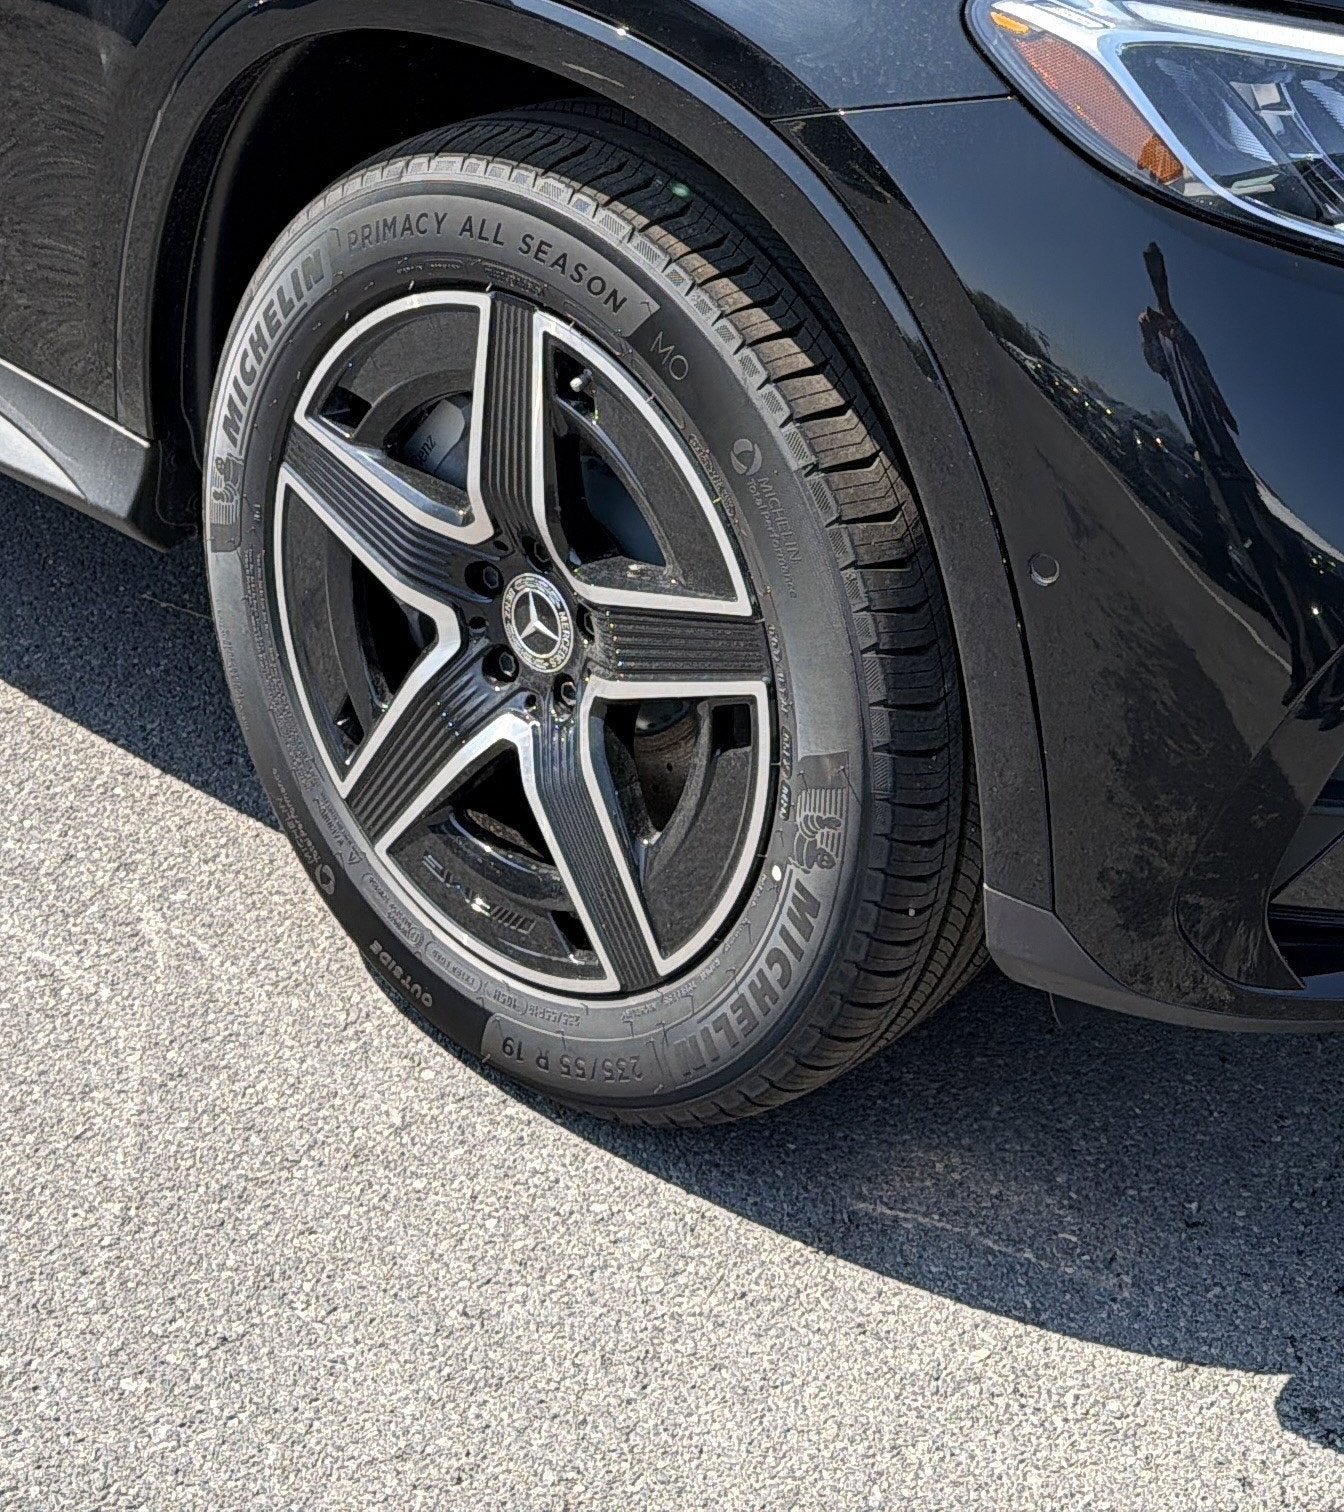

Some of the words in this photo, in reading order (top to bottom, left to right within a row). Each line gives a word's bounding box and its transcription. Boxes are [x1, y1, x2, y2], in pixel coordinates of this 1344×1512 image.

[347, 211, 449, 253] PRIMACY
[459, 215, 506, 247] ALL
[517, 233, 628, 314] SEASON
[222, 248, 325, 445] MICHELIN
[649, 330, 689, 381] MO
[758, 476, 803, 564] MICHELIN
[548, 610, 571, 668] MERCEDES
[368, 938, 434, 1008] OUTSIDE
[672, 876, 822, 1076] MICHELIN
[501, 1036, 525, 1062] 19
[535, 1049, 550, 1072] R
[558, 1052, 646, 1083] 235/55
